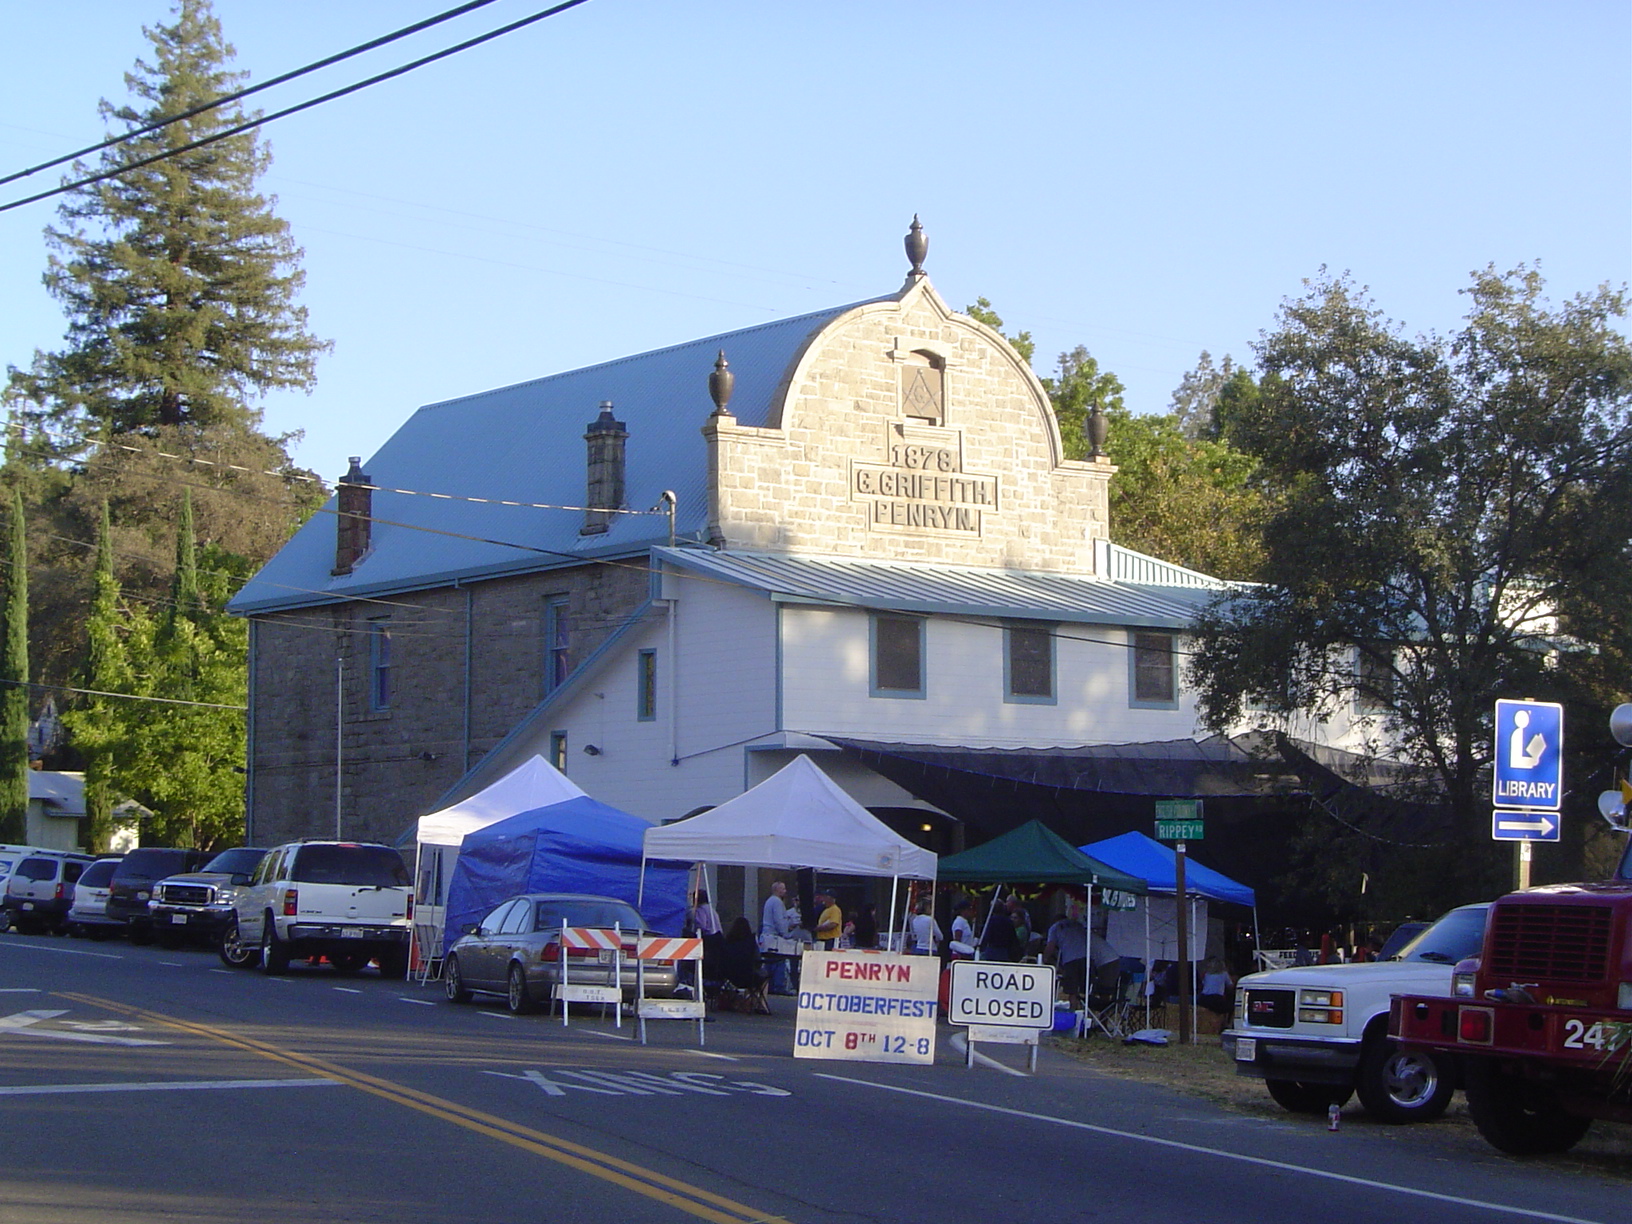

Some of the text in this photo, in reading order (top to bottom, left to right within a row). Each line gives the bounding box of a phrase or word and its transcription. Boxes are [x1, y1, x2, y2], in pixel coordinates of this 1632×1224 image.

[1498, 780, 1556, 799] LIBRARY
[1159, 825, 1194, 839] RIPPEY
[825, 960, 911, 983] PENRYN
[976, 971, 1035, 991] ROAD
[798, 991, 937, 1018] OCTOBERFEST
[961, 997, 1043, 1019] CLOSED
[797, 1029, 930, 1055] OCT 8TH 12-8
